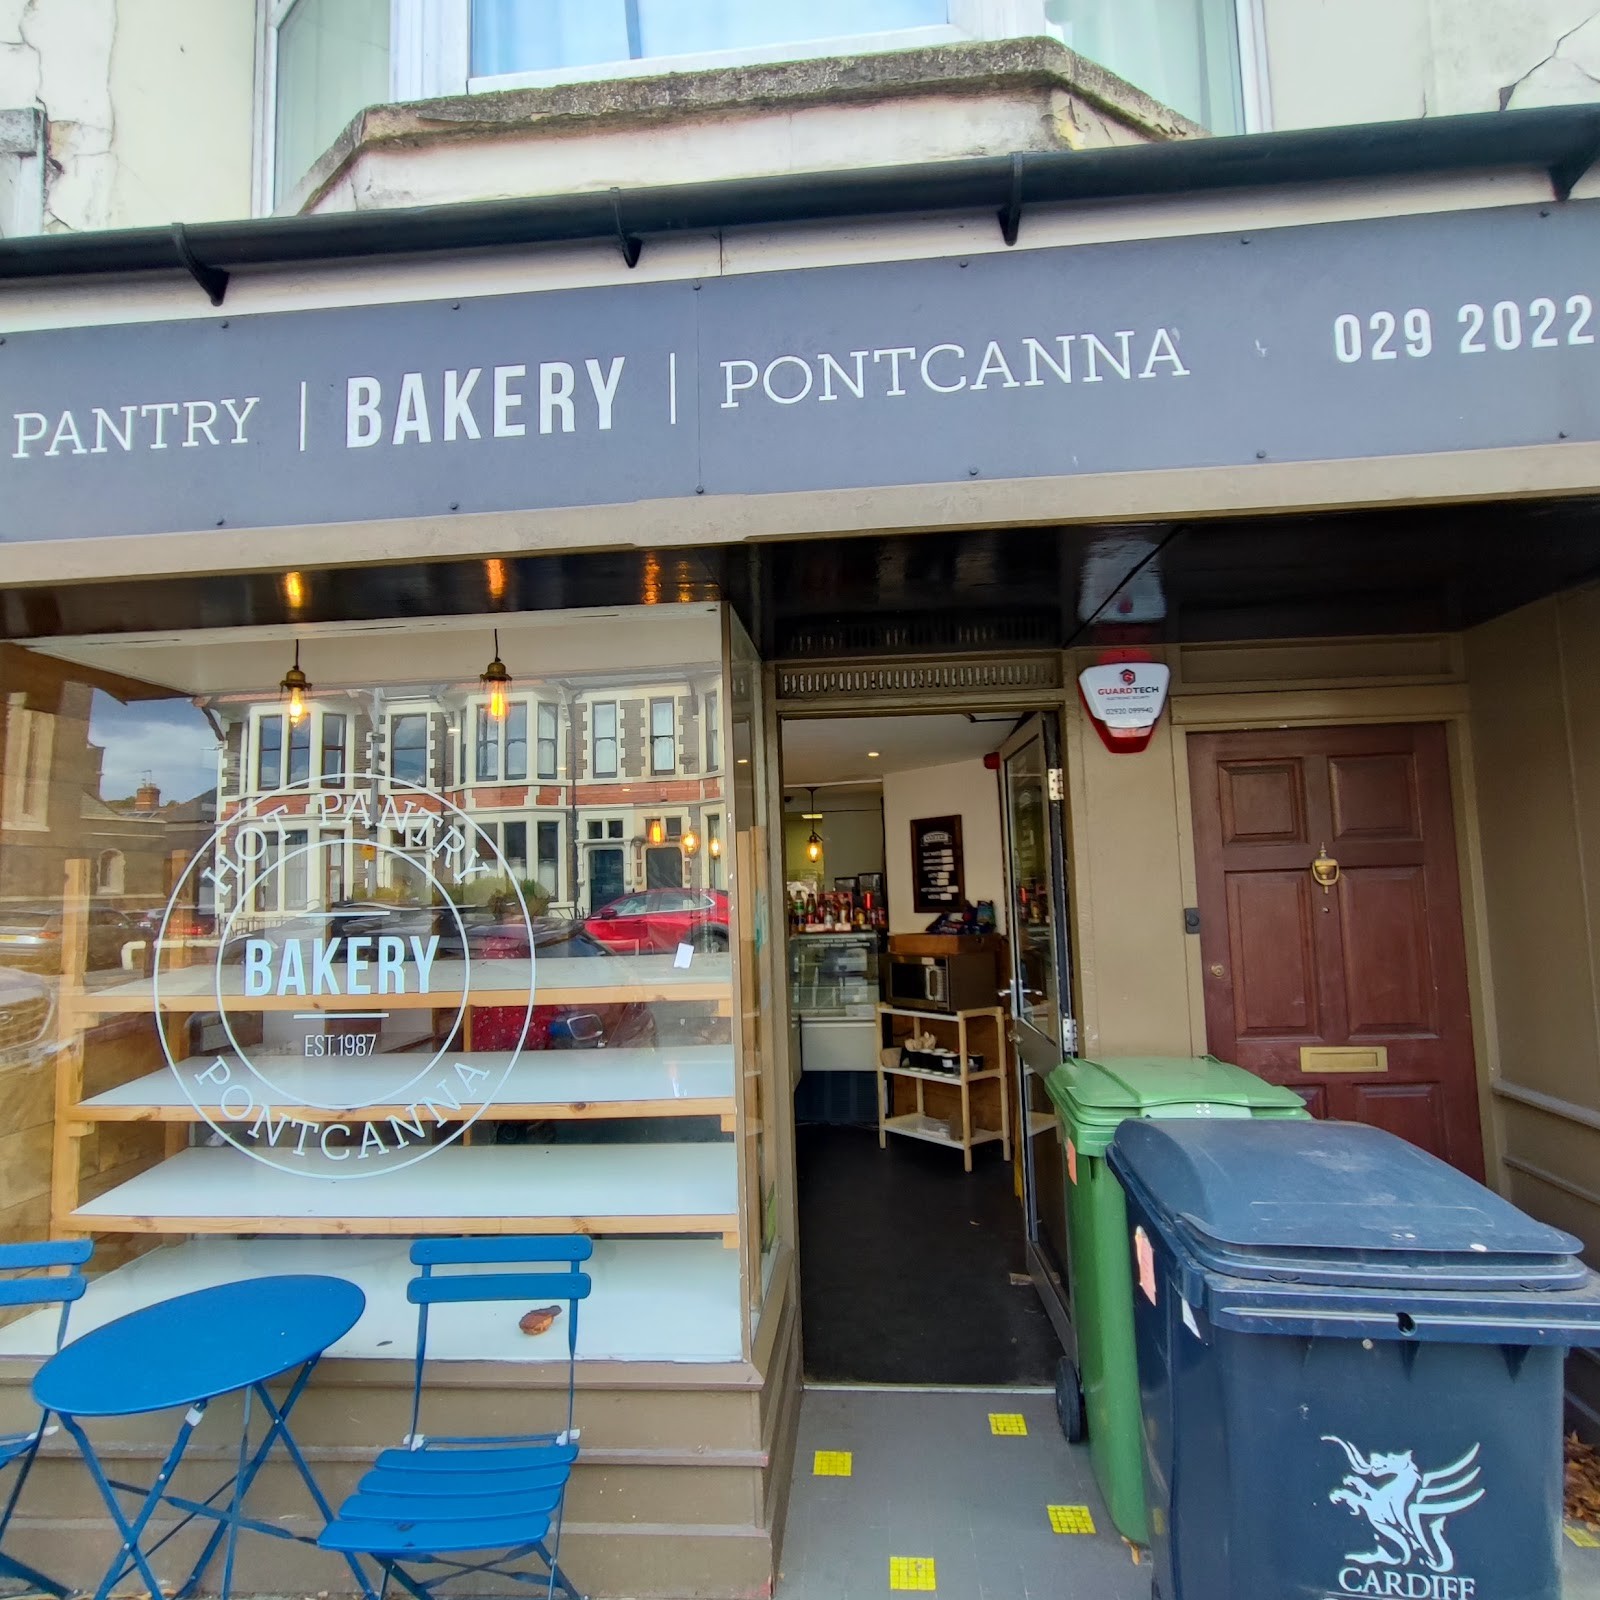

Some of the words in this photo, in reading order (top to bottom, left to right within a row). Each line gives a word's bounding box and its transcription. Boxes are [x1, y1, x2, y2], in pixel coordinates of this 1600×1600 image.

[11, 397, 260, 459] PANTRY
[346, 356, 625, 449] BAKERY
[719, 328, 1190, 409] PONTCANNA
[1334, 308, 1433, 364] 029
[1457, 294, 1595, 355] 2022
[1097, 686, 1159, 695] GUARDTECH
[202, 805, 291, 895] HOT
[317, 790, 492, 886] PANTRY
[245, 935, 440, 996] BAKERY
[194, 1055, 491, 1161] PONTCANNA
[1338, 1566, 1476, 1600] CARDIFF
